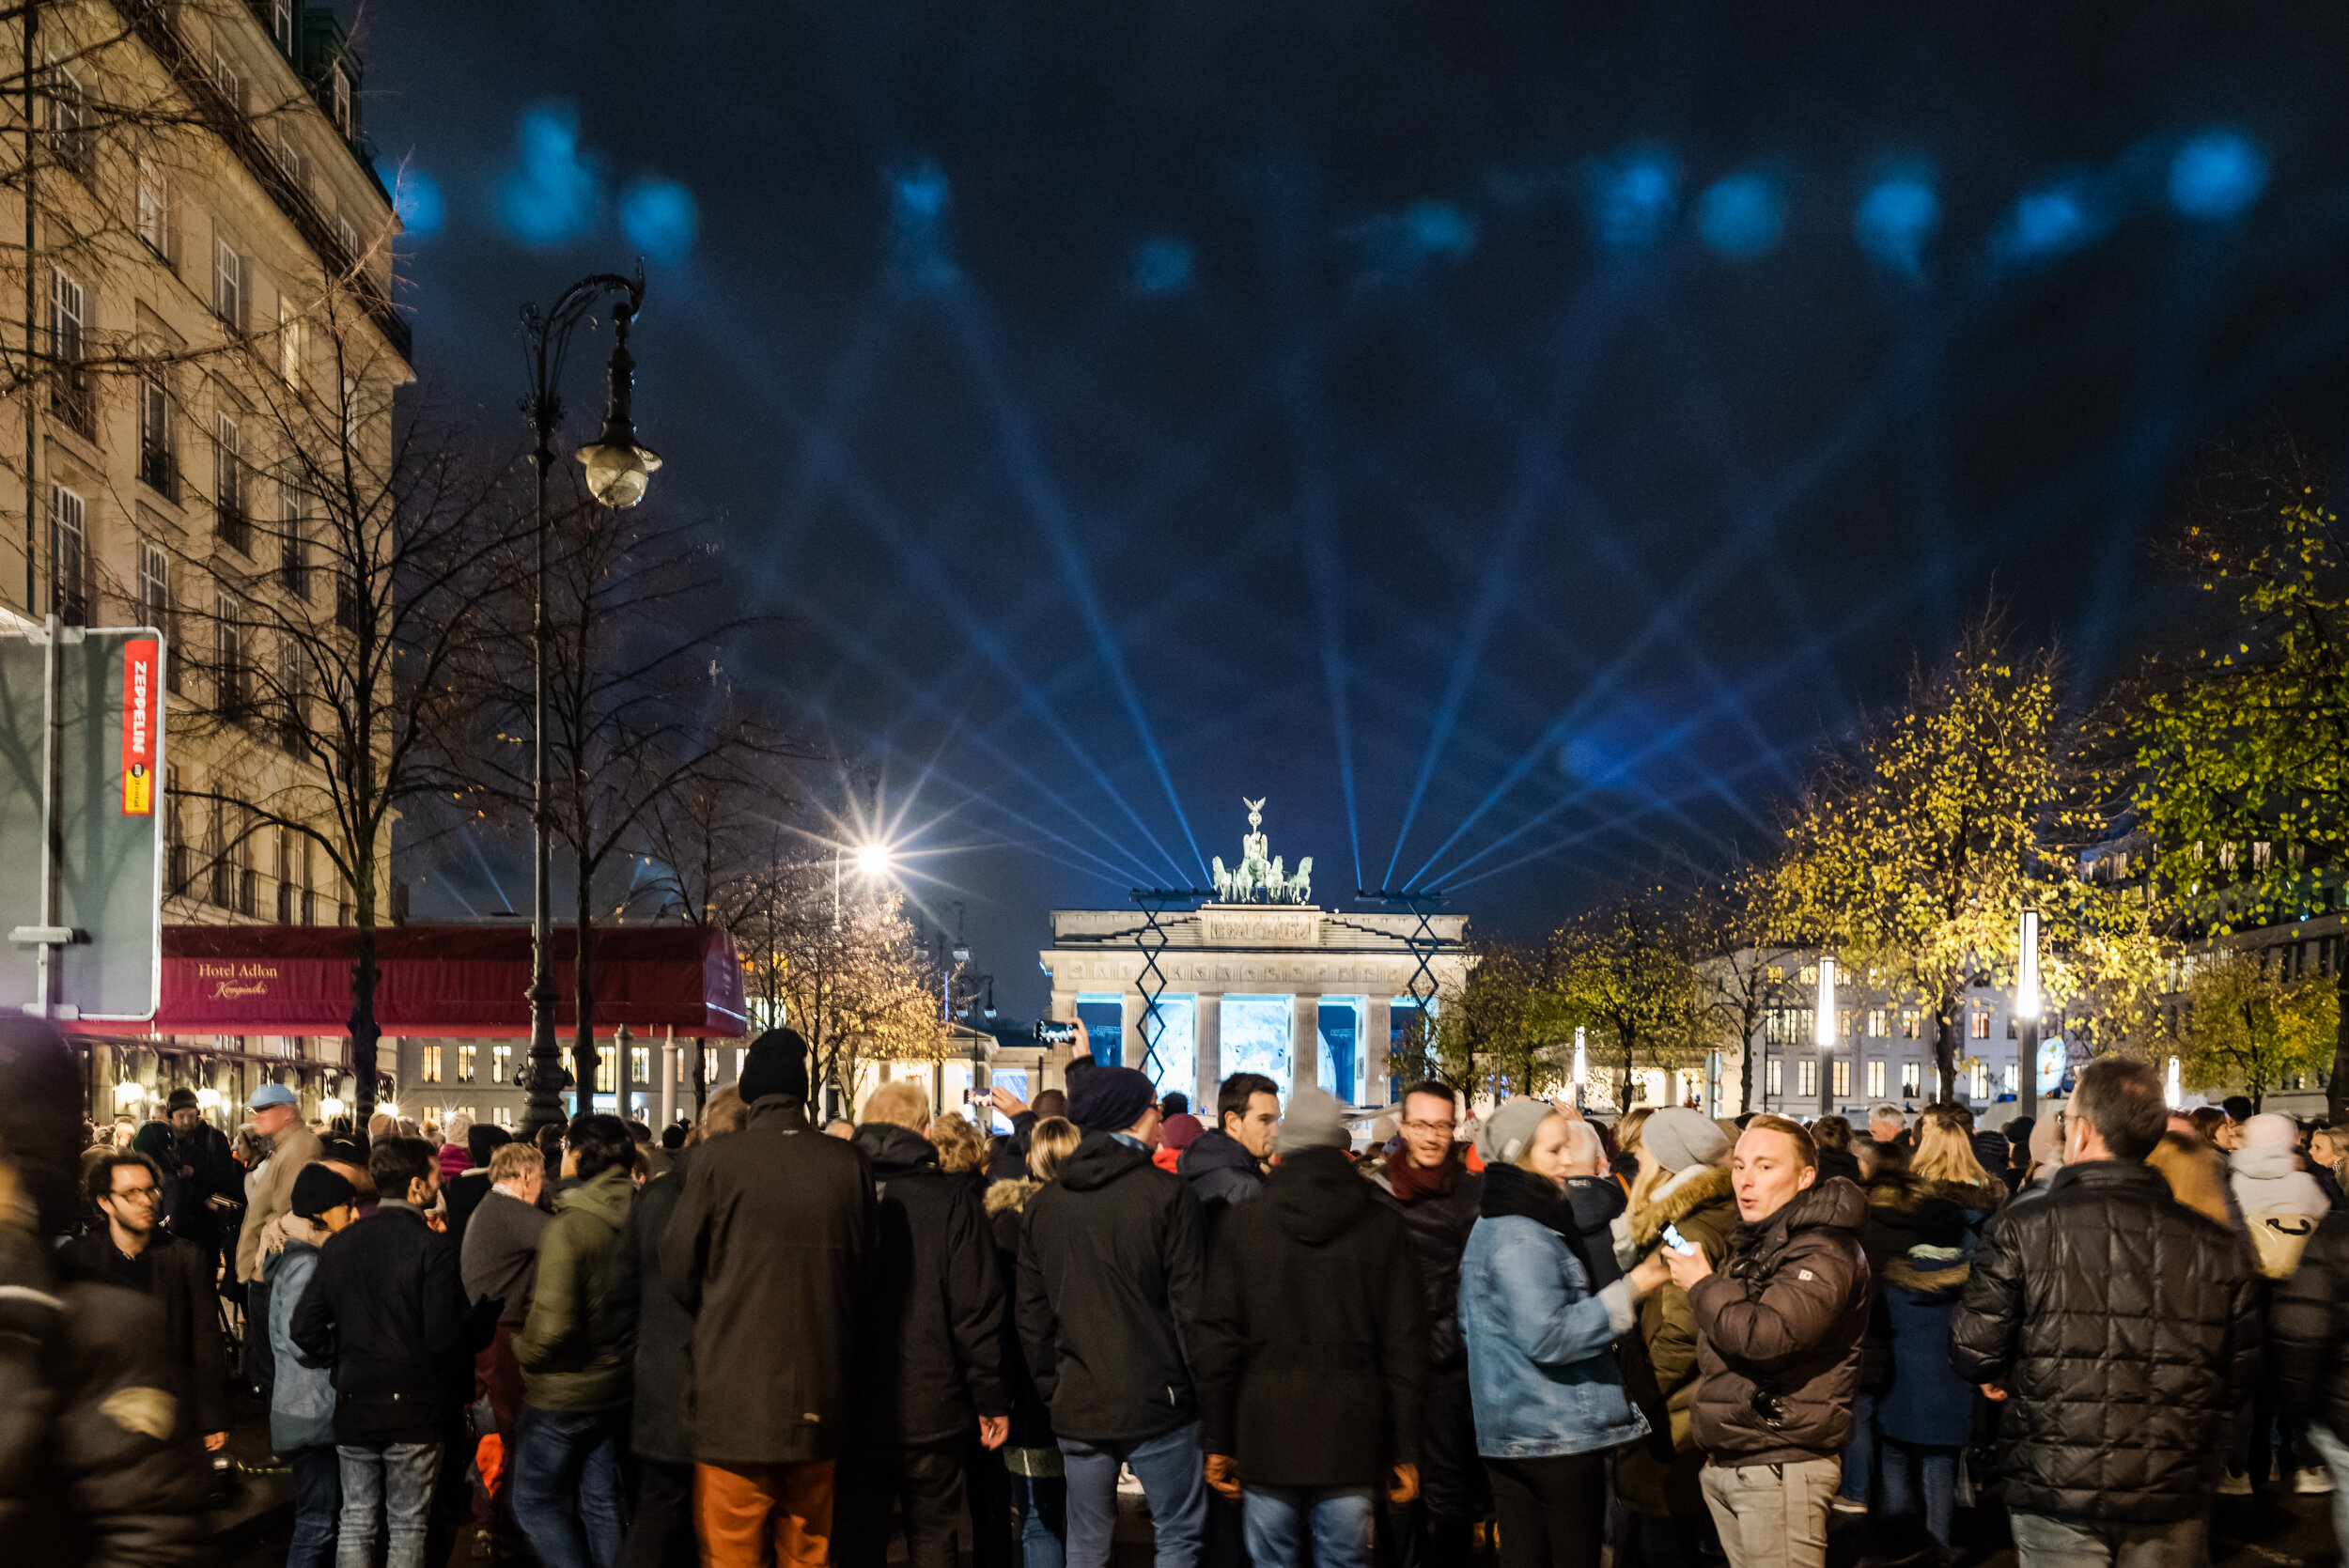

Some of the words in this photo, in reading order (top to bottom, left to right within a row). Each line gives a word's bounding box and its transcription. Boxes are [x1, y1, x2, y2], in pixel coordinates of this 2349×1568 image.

[132, 660, 148, 755] ZEPPELIN
[198, 963, 235, 978] Hotel
[239, 963, 278, 978] Adlon
